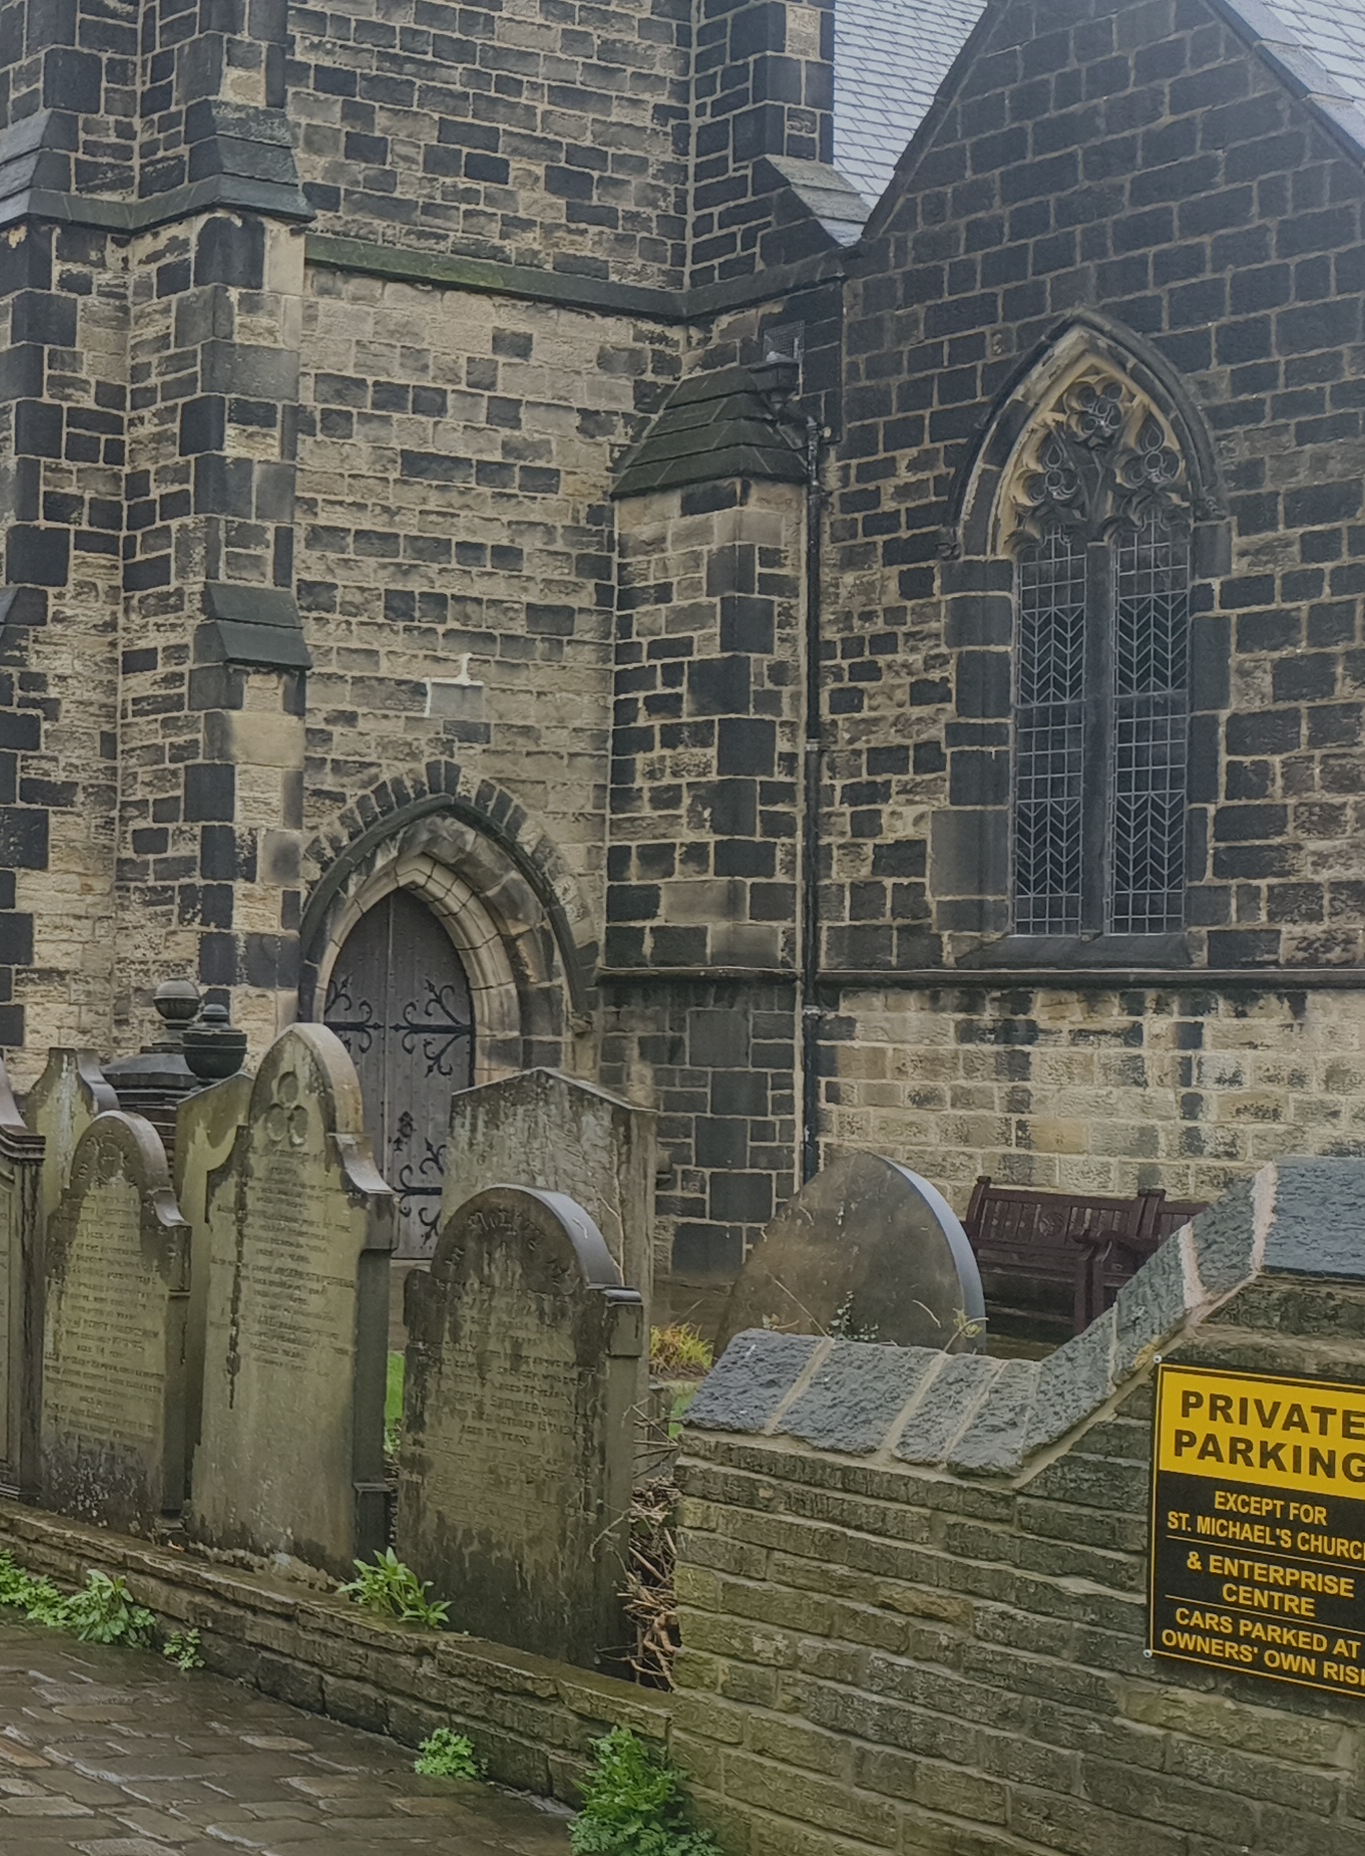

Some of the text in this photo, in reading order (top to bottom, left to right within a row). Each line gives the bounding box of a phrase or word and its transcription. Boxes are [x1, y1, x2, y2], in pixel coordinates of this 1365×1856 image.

[1181, 1389, 1365, 1441] PRIVATE
[1174, 1429, 1365, 1483] PARKING
[1167, 1511, 1192, 1532] ST.
[1196, 1515, 1292, 1548] MICHAEL'S
[1214, 1490, 1327, 1526] EXCEPT FOR
[1186, 1551, 1354, 1597] & ENTERPRISE
[1222, 1583, 1316, 1618] CENTRE
[1161, 1630, 1259, 1662] OWNERS'
[1263, 1649, 1316, 1675] OWN
[1175, 1607, 1361, 1659] CARS PARKED AT
